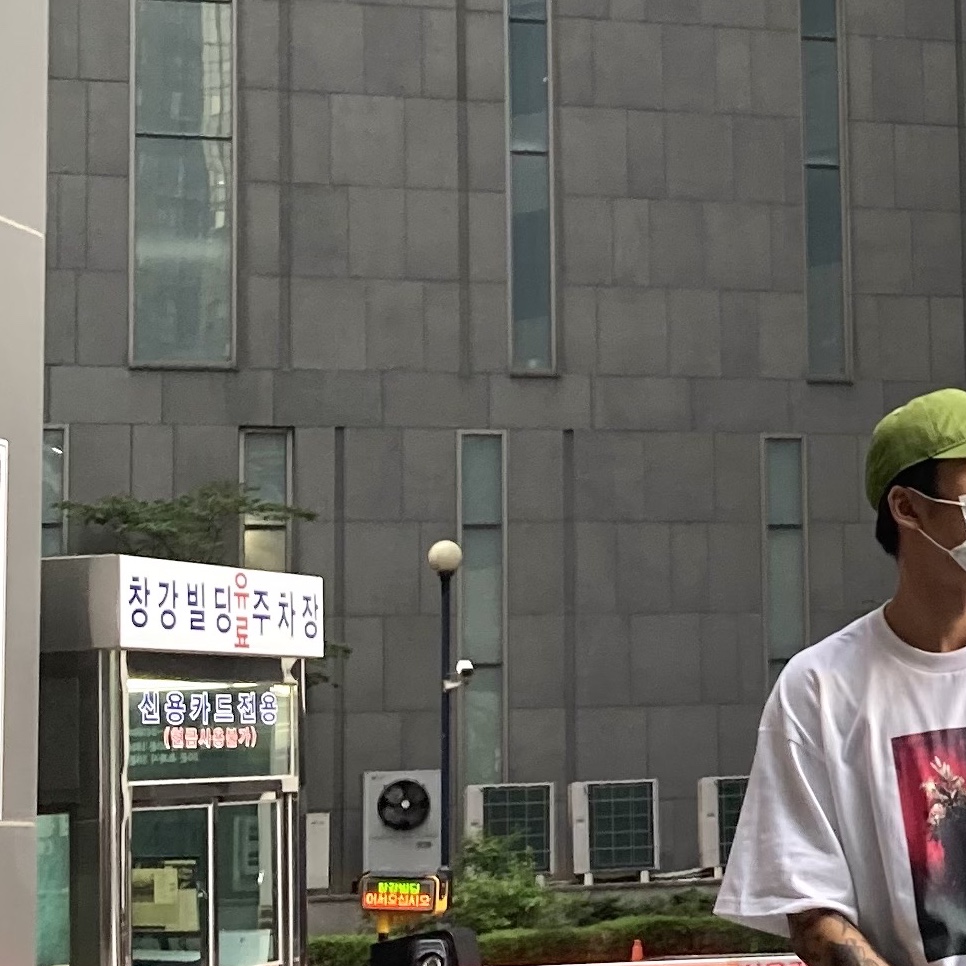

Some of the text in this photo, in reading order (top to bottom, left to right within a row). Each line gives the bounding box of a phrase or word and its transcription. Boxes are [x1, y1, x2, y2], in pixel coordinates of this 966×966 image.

[128, 572, 319, 648] 창강빌딩 유료 주차장
[138, 690, 279, 725] 신용카드전용
[365, 893, 431, 907] 어서오십시오
